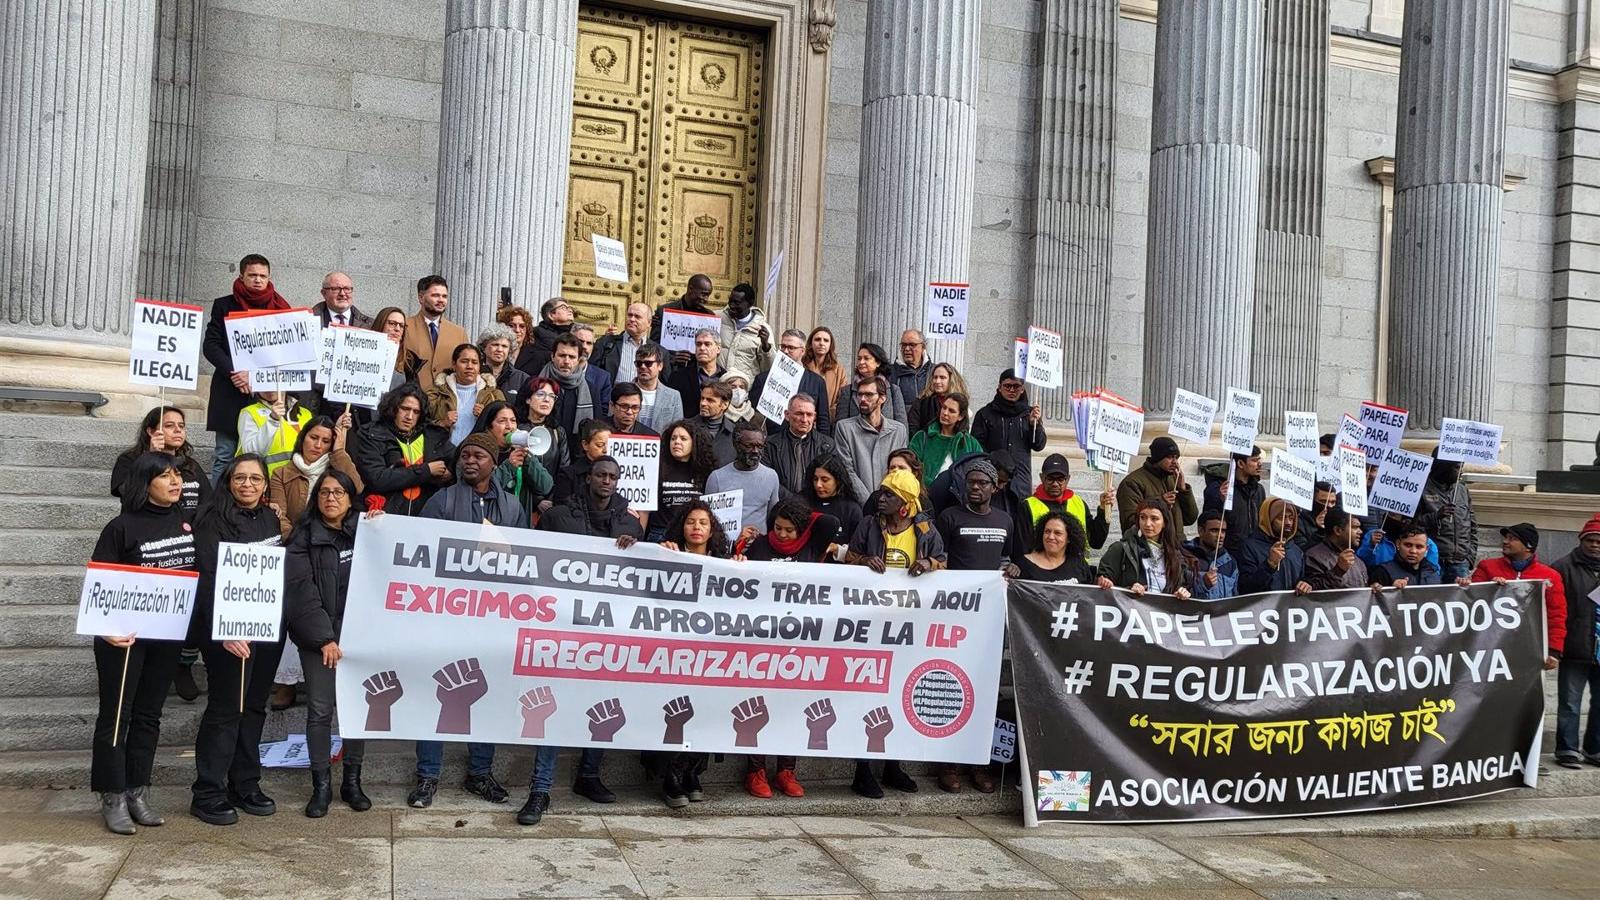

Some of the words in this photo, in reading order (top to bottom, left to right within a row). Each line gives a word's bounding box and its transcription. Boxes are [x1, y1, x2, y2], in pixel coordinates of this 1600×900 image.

[933, 288, 966, 300] NADIE
[142, 306, 198, 330] NADIE
[942, 306, 954, 317] ES
[232, 324, 294, 356] ¡Regularización
[293, 320, 309, 343] YA!
[928, 323, 965, 336] ILEGAL
[157, 335, 177, 353] ES
[344, 332, 378, 351] Mejoremos
[336, 355, 344, 370] el
[344, 356, 380, 376] Reglamento
[778, 354, 798, 377] Modificar
[1035, 348, 1050, 365] PARA
[132, 359, 194, 382] ILEGAL
[1030, 366, 1052, 383] TODOS!
[333, 378, 340, 394] de
[342, 380, 378, 400] Extranjería.
[1232, 392, 1256, 408] Mejoremos
[1230, 412, 1256, 428] Reglamento
[1288, 414, 1305, 430] Acoje
[1306, 418, 1316, 432] por
[1360, 408, 1405, 428] ¡PAPELES
[1364, 426, 1389, 444] PARA
[1445, 423, 1456, 432] 500
[1456, 424, 1464, 432] mil
[1465, 426, 1482, 436] firmas
[610, 442, 658, 458] ¡PAPELES
[1289, 435, 1316, 448] derechos
[1440, 444, 1460, 454] Papeles
[1486, 440, 1496, 448] YA!
[1384, 448, 1411, 470] Acoje
[1410, 461, 1429, 474] por
[620, 465, 646, 480] PARA
[1346, 472, 1360, 488] PARA
[1380, 472, 1420, 494] derechos
[1344, 492, 1362, 510] TODOS!
[1371, 492, 1411, 514] humanos.
[222, 548, 258, 574] Acoje
[260, 556, 281, 576] por
[392, 542, 431, 569] LA
[444, 546, 539, 579] LUCHA
[552, 558, 695, 595] COLECTIVA
[705, 575, 760, 600] NOS
[772, 582, 832, 606] TRAE
[842, 587, 922, 609] HASTA
[931, 588, 982, 612] AQUÍ
[85, 581, 170, 616] ¡Regularización
[172, 588, 191, 616] YA!
[222, 580, 276, 604] derechos
[384, 581, 558, 622] EXIGIMOS
[572, 598, 615, 628] LA
[630, 605, 823, 642] APROBACIÓN
[833, 617, 872, 644] DE
[881, 621, 914, 646] LA
[925, 623, 968, 648] ILP
[1050, 602, 1079, 640] #
[1094, 604, 1280, 646] PAPELES
[1288, 605, 1394, 642] PARA
[1398, 596, 1522, 636] TODOS
[218, 614, 275, 638] humanos.
[520, 638, 829, 682] ¡REGULARIZACIÓN
[842, 656, 886, 685] YA!
[1064, 660, 1094, 694] #
[1106, 646, 1453, 702] REGULARIZACIÓN
[1460, 648, 1514, 684] YA
[1000, 734, 1014, 746] ES
[1246, 719, 1310, 755] জন্য
[1315, 710, 1395, 752] কাগজ
[1094, 772, 1287, 807] ASOCIACIÓN
[1296, 765, 1424, 802] VALIENTE
[1432, 751, 1526, 789] BANGLA
